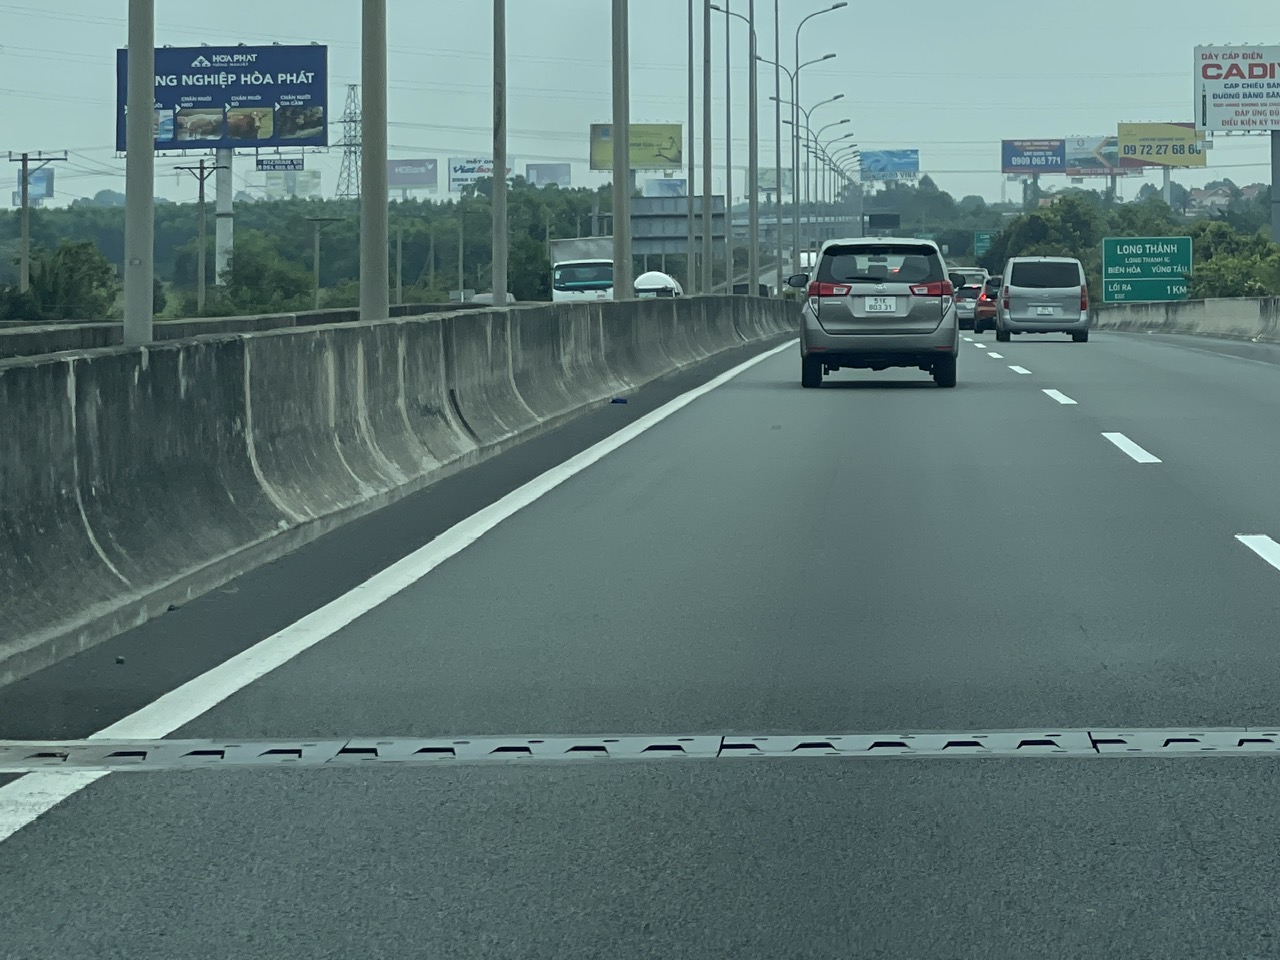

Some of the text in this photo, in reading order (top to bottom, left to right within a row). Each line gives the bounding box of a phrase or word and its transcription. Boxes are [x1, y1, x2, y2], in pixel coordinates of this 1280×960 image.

[155, 70, 315, 88] NG NGHIỆP HÒA PHÁT
[1123, 144, 1137, 155] 09
[1139, 144, 1153, 155] 72
[1155, 144, 1169, 155] 27
[1172, 144, 1185, 155] 68
[1117, 244, 1143, 254] LONG
[1108, 265, 1125, 274] BIÊN
[1121, 283, 1132, 291] RA
[1167, 285, 1187, 295] 1 KM
